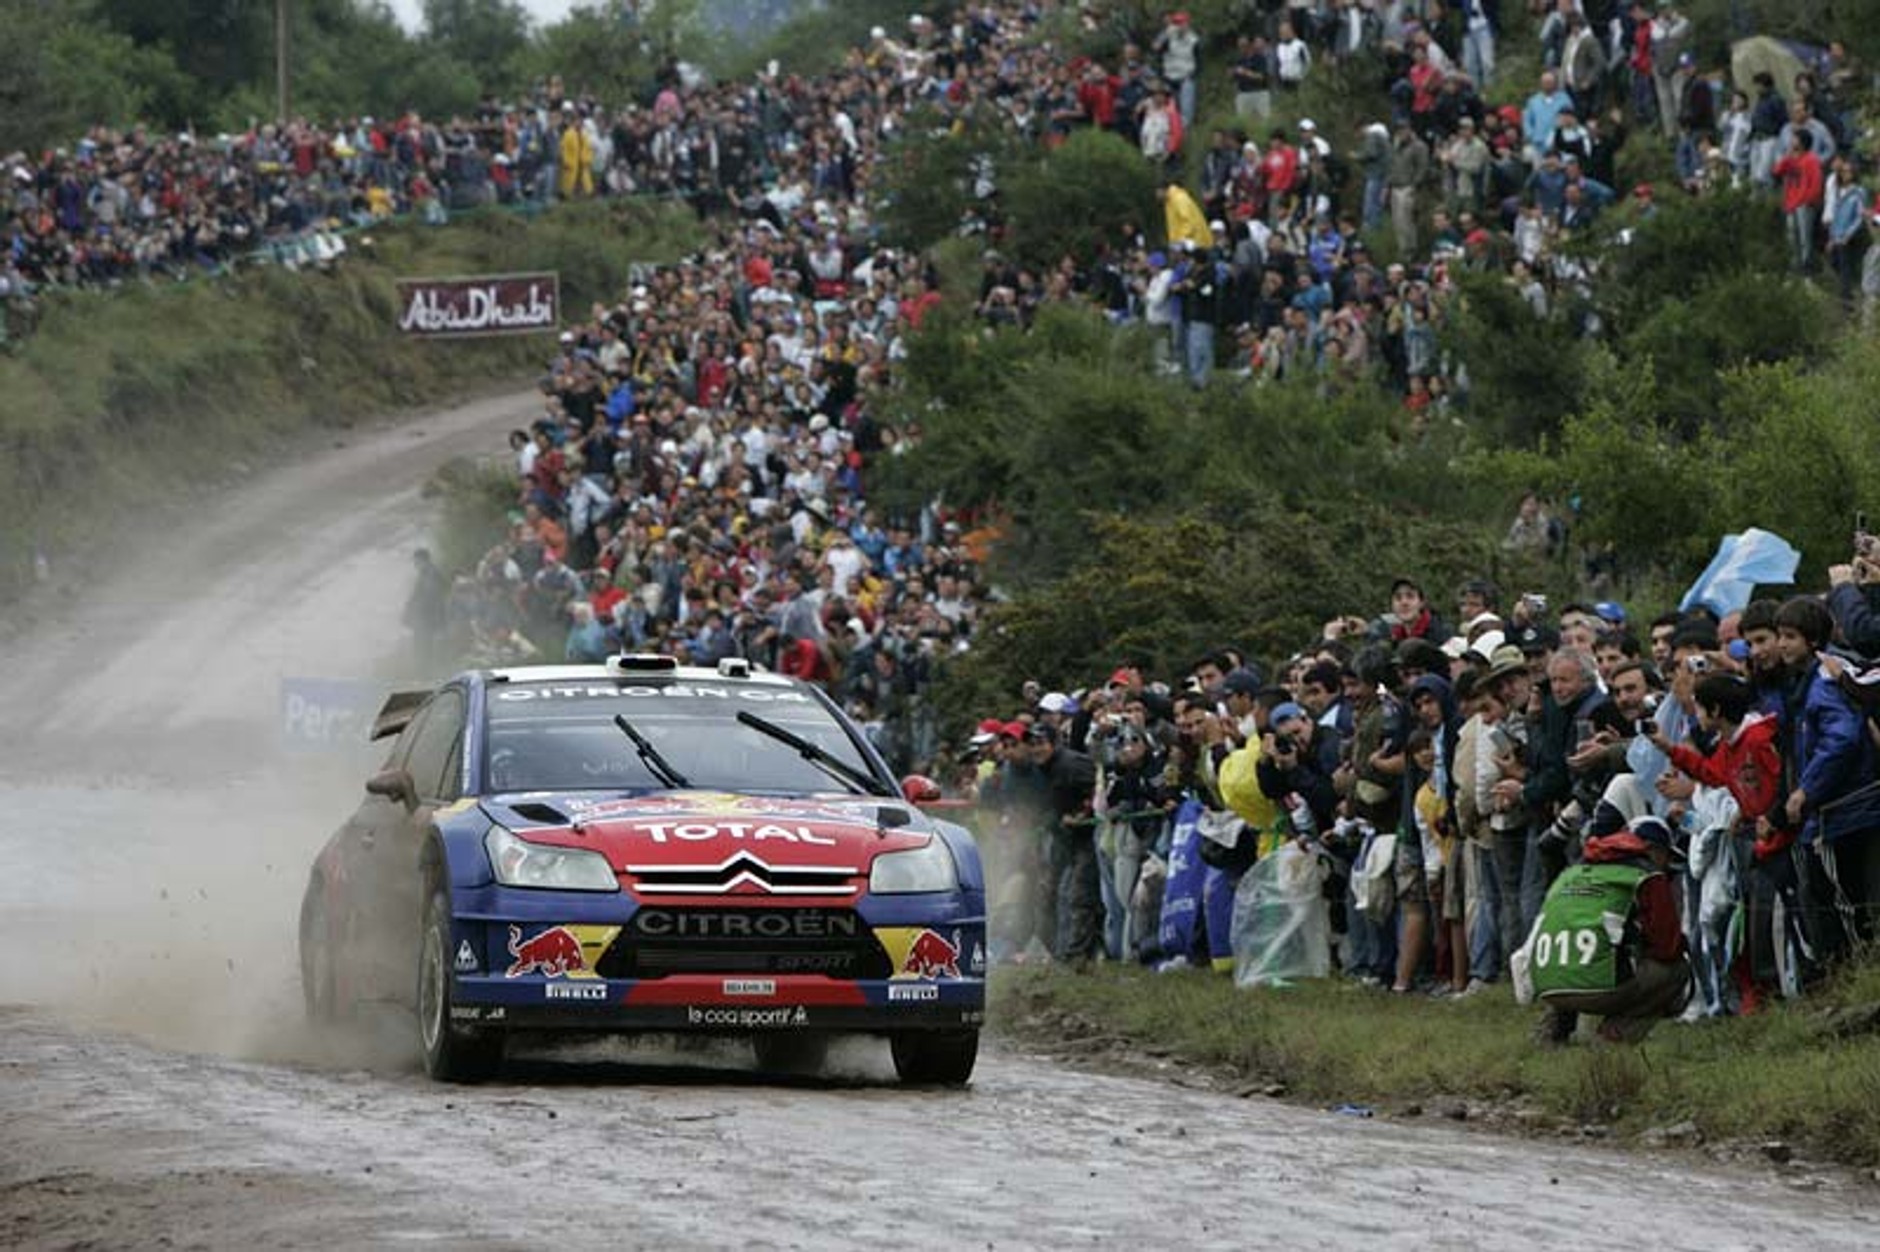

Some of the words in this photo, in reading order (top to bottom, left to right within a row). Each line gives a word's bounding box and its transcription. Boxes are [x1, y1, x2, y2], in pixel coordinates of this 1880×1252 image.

[634, 822, 836, 846] TOTAL
[636, 908, 855, 936] CITROËN
[1536, 929, 1598, 968] 019
[776, 953, 856, 970] SPORT
[545, 983, 607, 999] PIRELLI
[688, 1005, 703, 1023] le
[704, 1009, 738, 1024] coq
[740, 1006, 791, 1027] sportif
